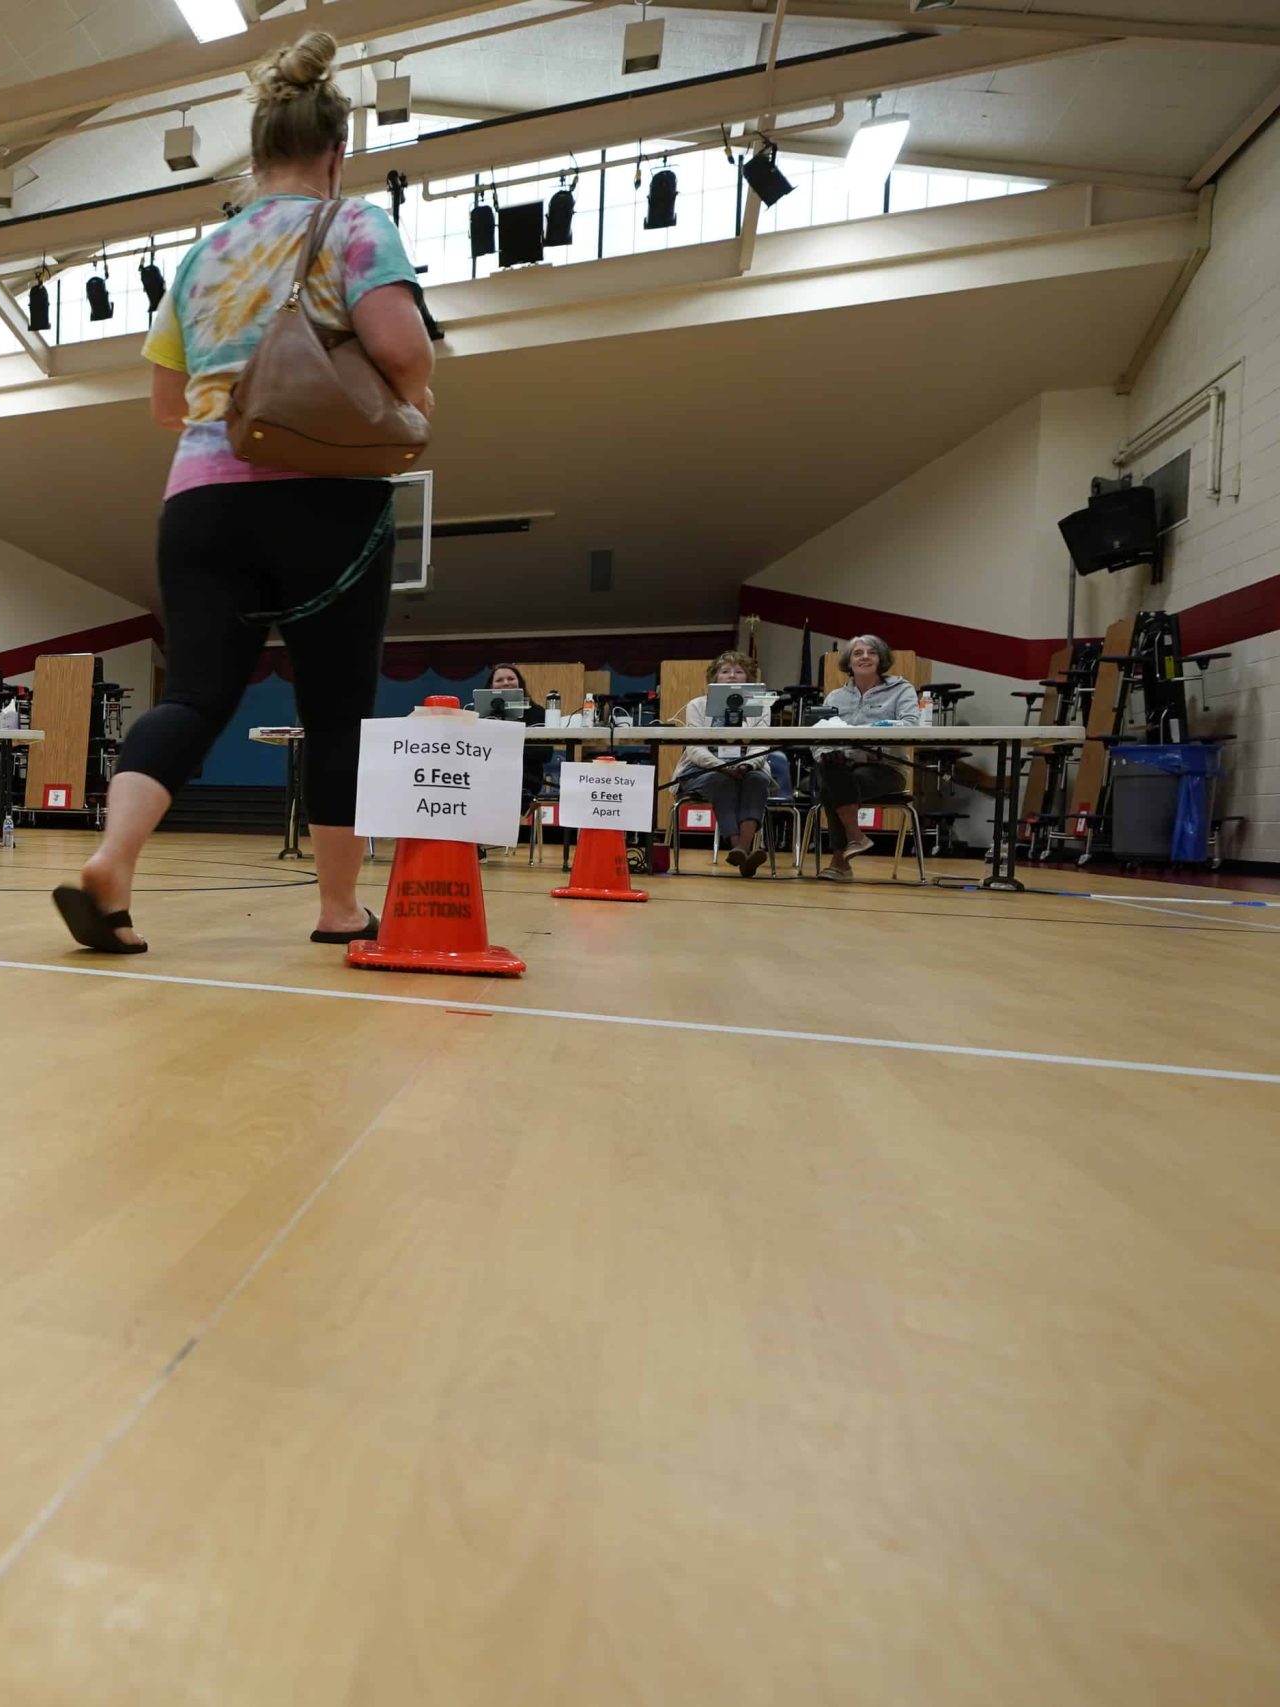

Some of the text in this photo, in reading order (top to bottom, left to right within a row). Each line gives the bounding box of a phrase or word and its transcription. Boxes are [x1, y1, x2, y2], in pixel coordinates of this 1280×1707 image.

[393, 739, 492, 761] Please Stay
[413, 768, 471, 786] 6 Feet
[579, 775, 636, 787] Please Stay
[591, 791, 623, 801] 6 Feet
[416, 798, 468, 817] Apart
[592, 807, 621, 817] Apart
[397, 880, 470, 897] HENRICO
[393, 901, 472, 919] ELECTIONS
